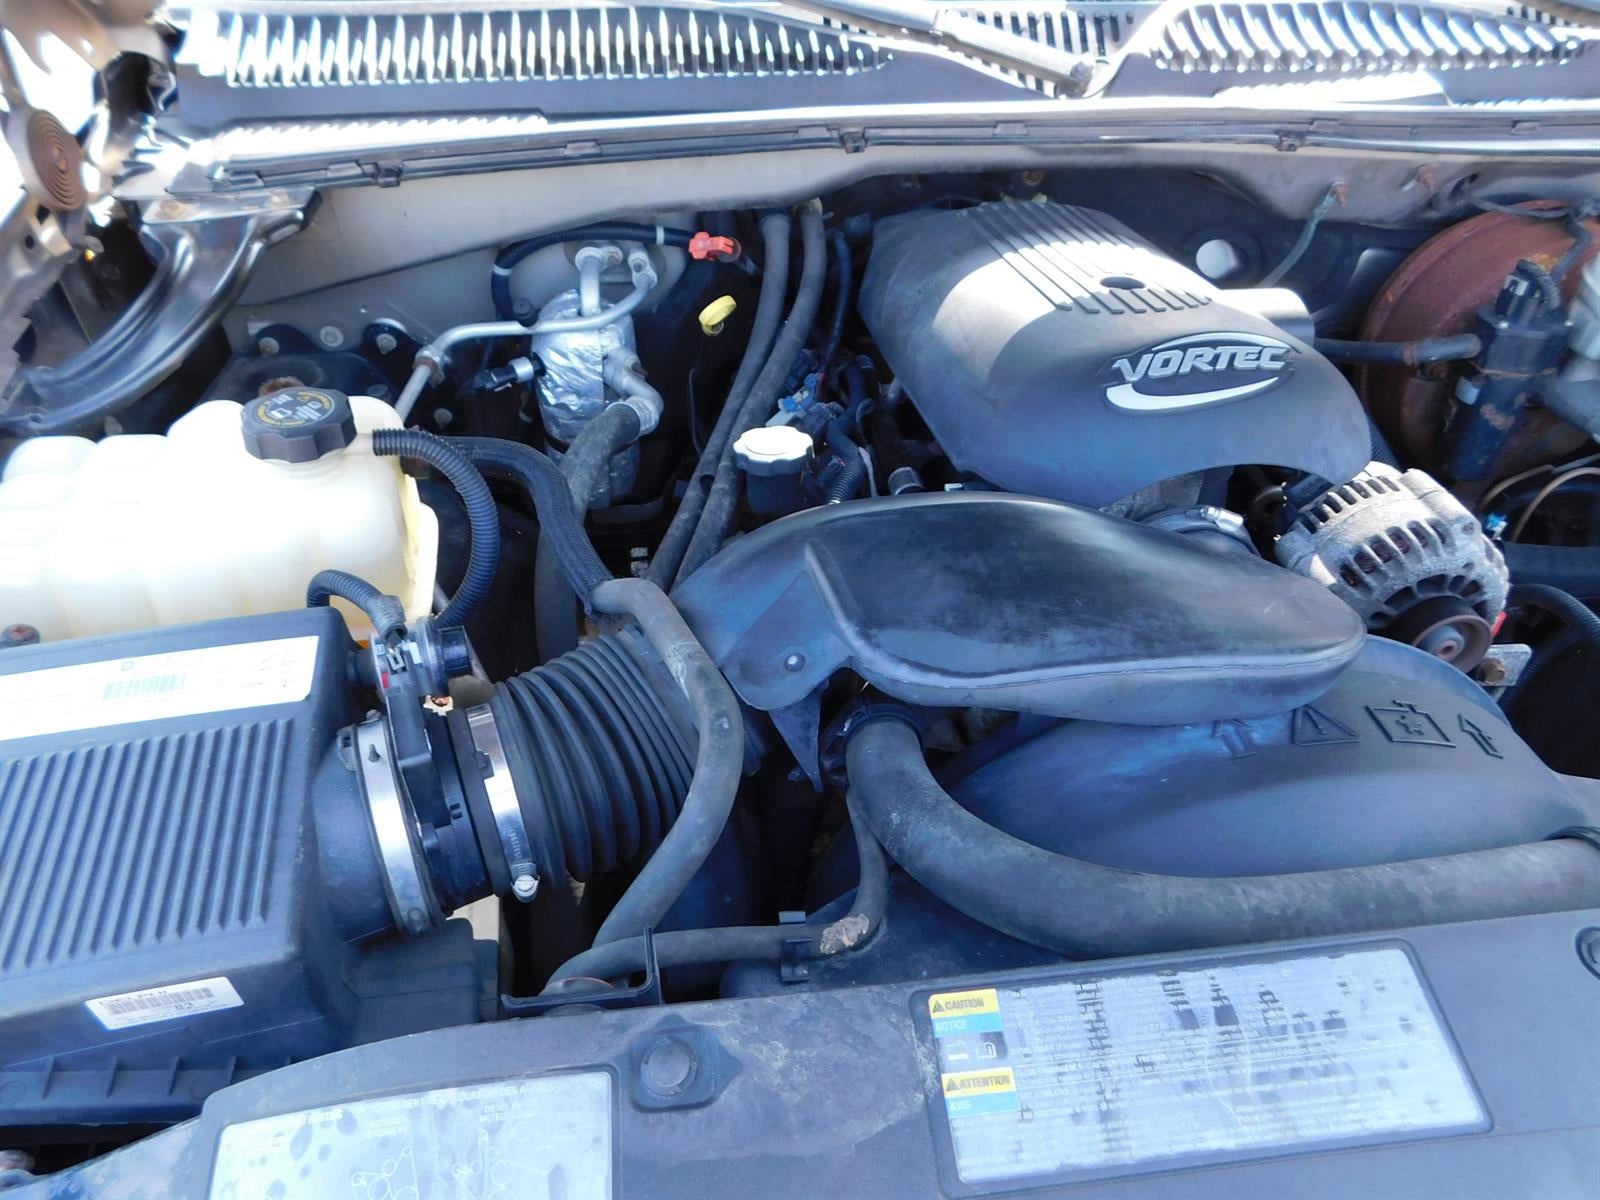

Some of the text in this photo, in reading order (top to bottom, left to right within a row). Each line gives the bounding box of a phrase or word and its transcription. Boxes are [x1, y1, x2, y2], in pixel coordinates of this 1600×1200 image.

[1112, 346, 1288, 382] VORTEC
[944, 998, 985, 1011] CAUTION
[959, 1075, 1010, 1089] ATTENTION
